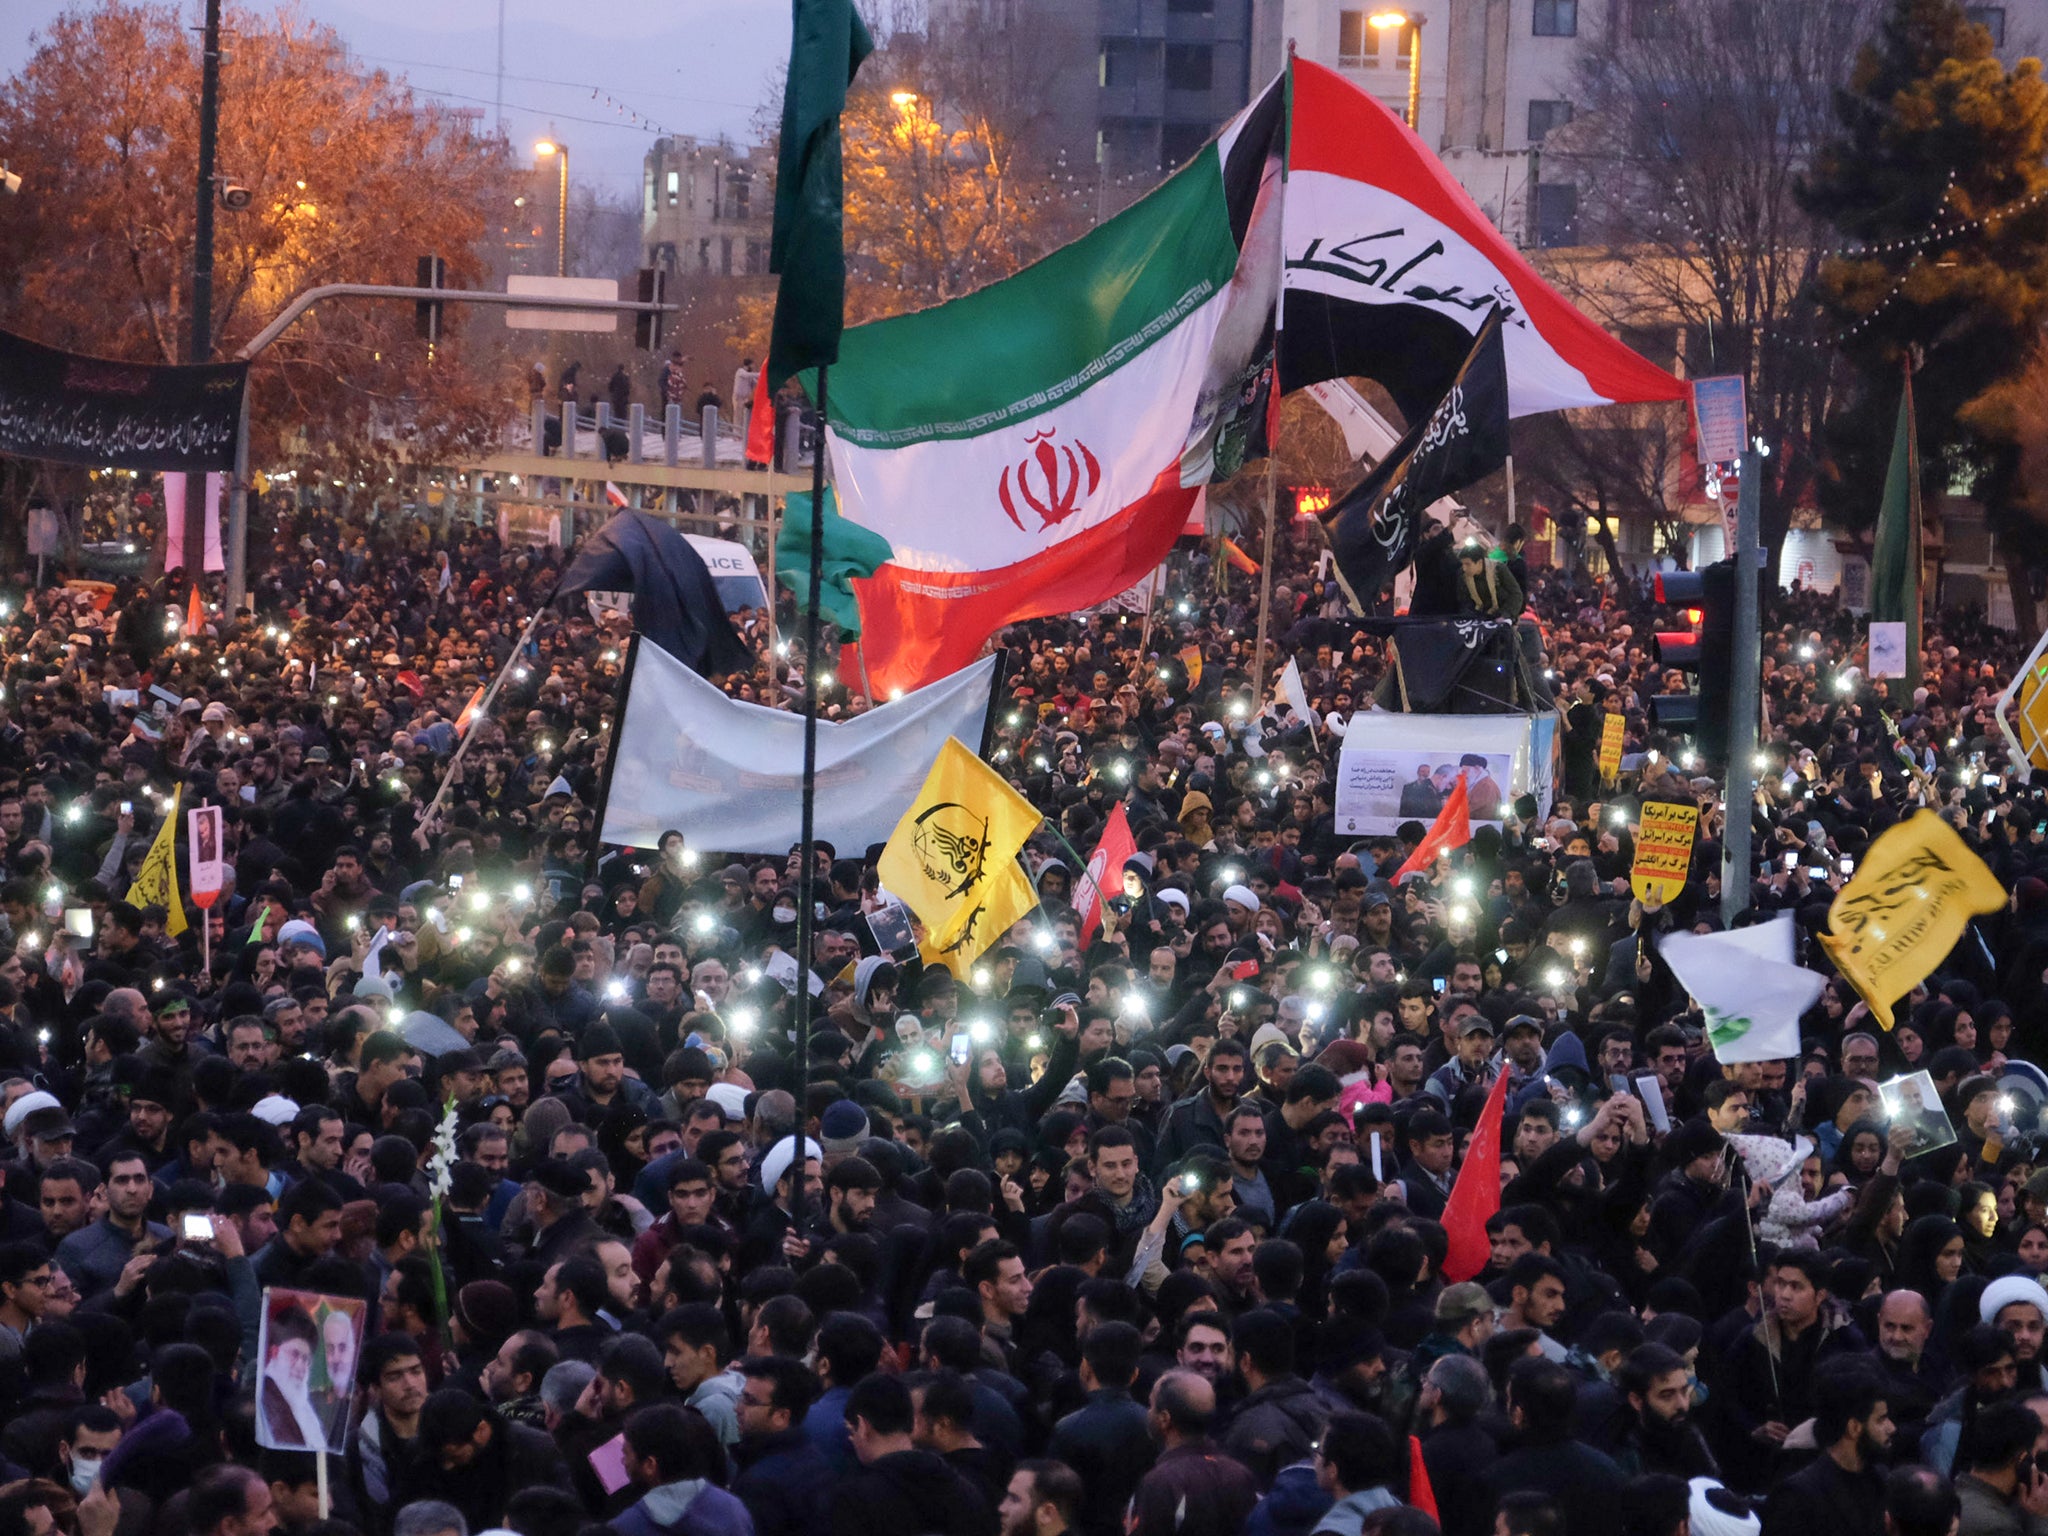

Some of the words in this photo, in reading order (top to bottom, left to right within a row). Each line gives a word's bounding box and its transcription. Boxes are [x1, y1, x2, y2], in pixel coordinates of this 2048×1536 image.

[1645, 806, 1670, 820] آمریکا
[1668, 811, 1677, 821] بر
[1677, 811, 1695, 824] مرگ
[1640, 830, 1665, 842] اسرائیل
[1665, 836, 1673, 844] بر
[1675, 835, 1691, 846] مرگ
[1669, 859, 1687, 870] مرگ
